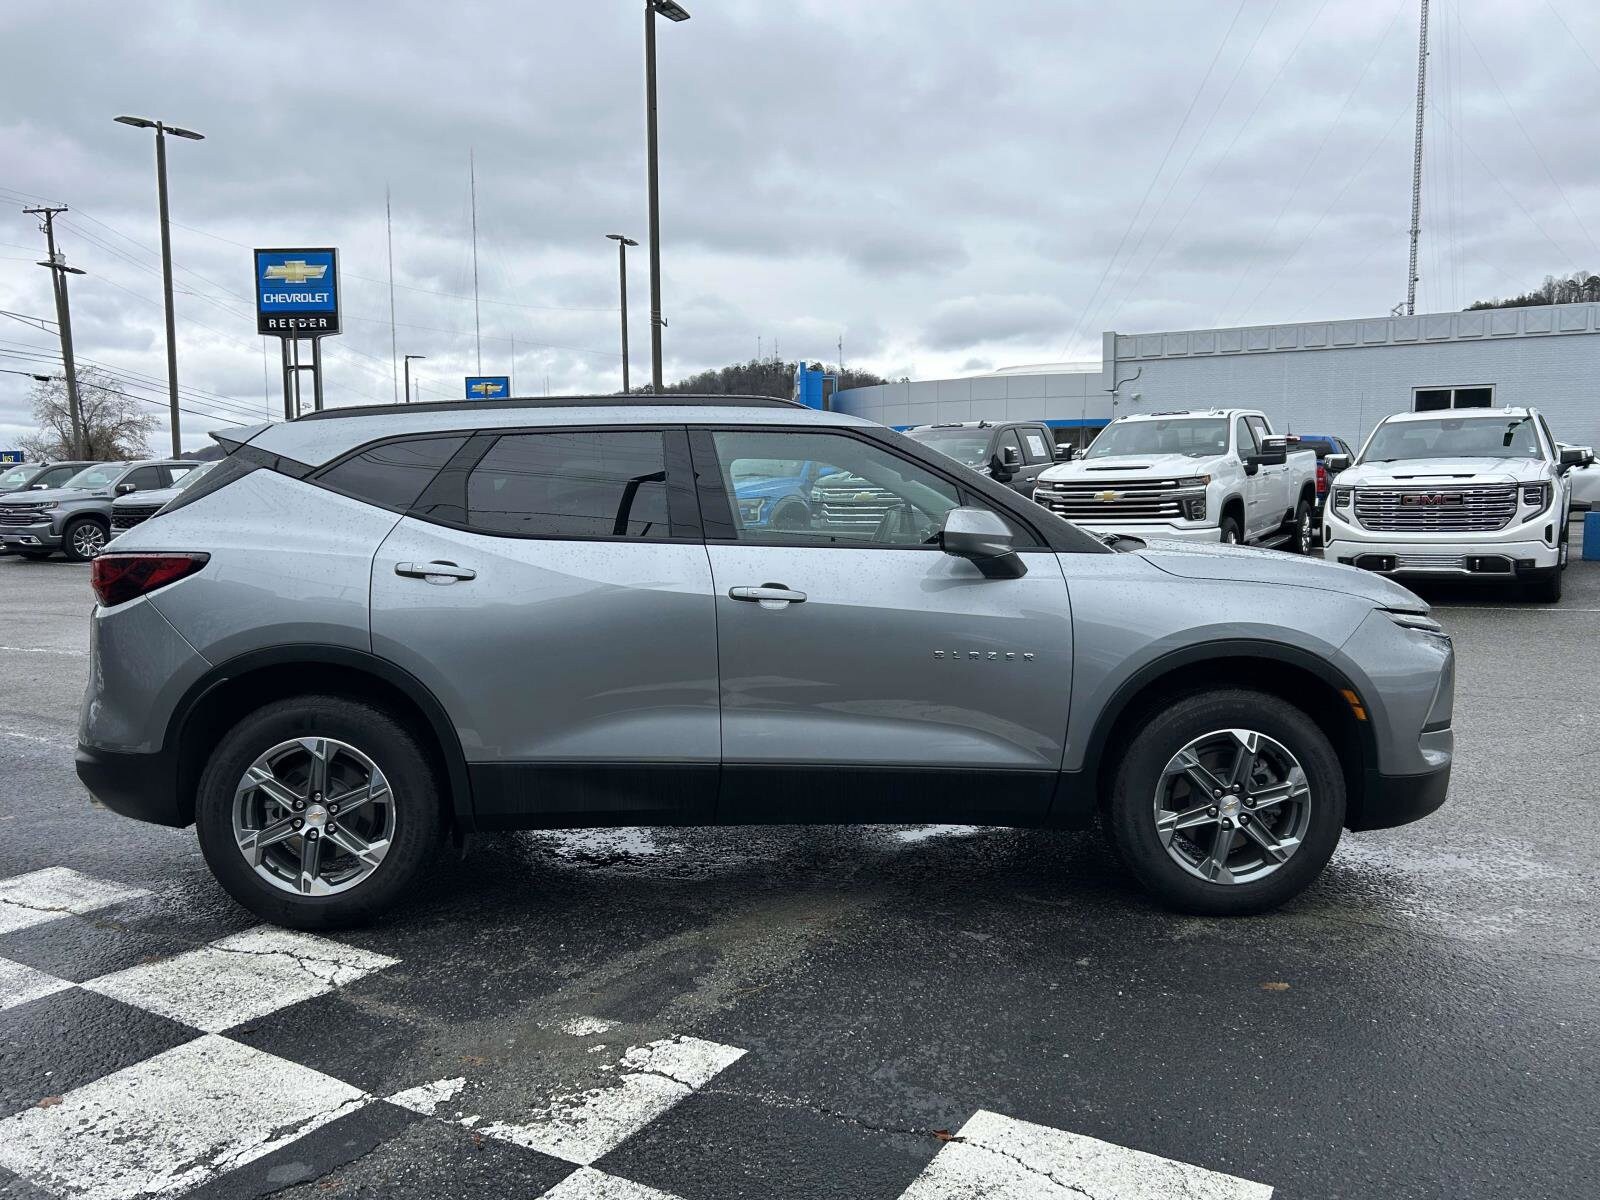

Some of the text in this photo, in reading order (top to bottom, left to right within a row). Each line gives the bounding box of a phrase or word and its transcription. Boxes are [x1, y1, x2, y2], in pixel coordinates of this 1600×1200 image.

[263, 292, 329, 303] CHEVROLET
[268, 318, 327, 328] REEDER
[1402, 494, 1461, 506] GMC
[933, 650, 1034, 661] BLAZER
